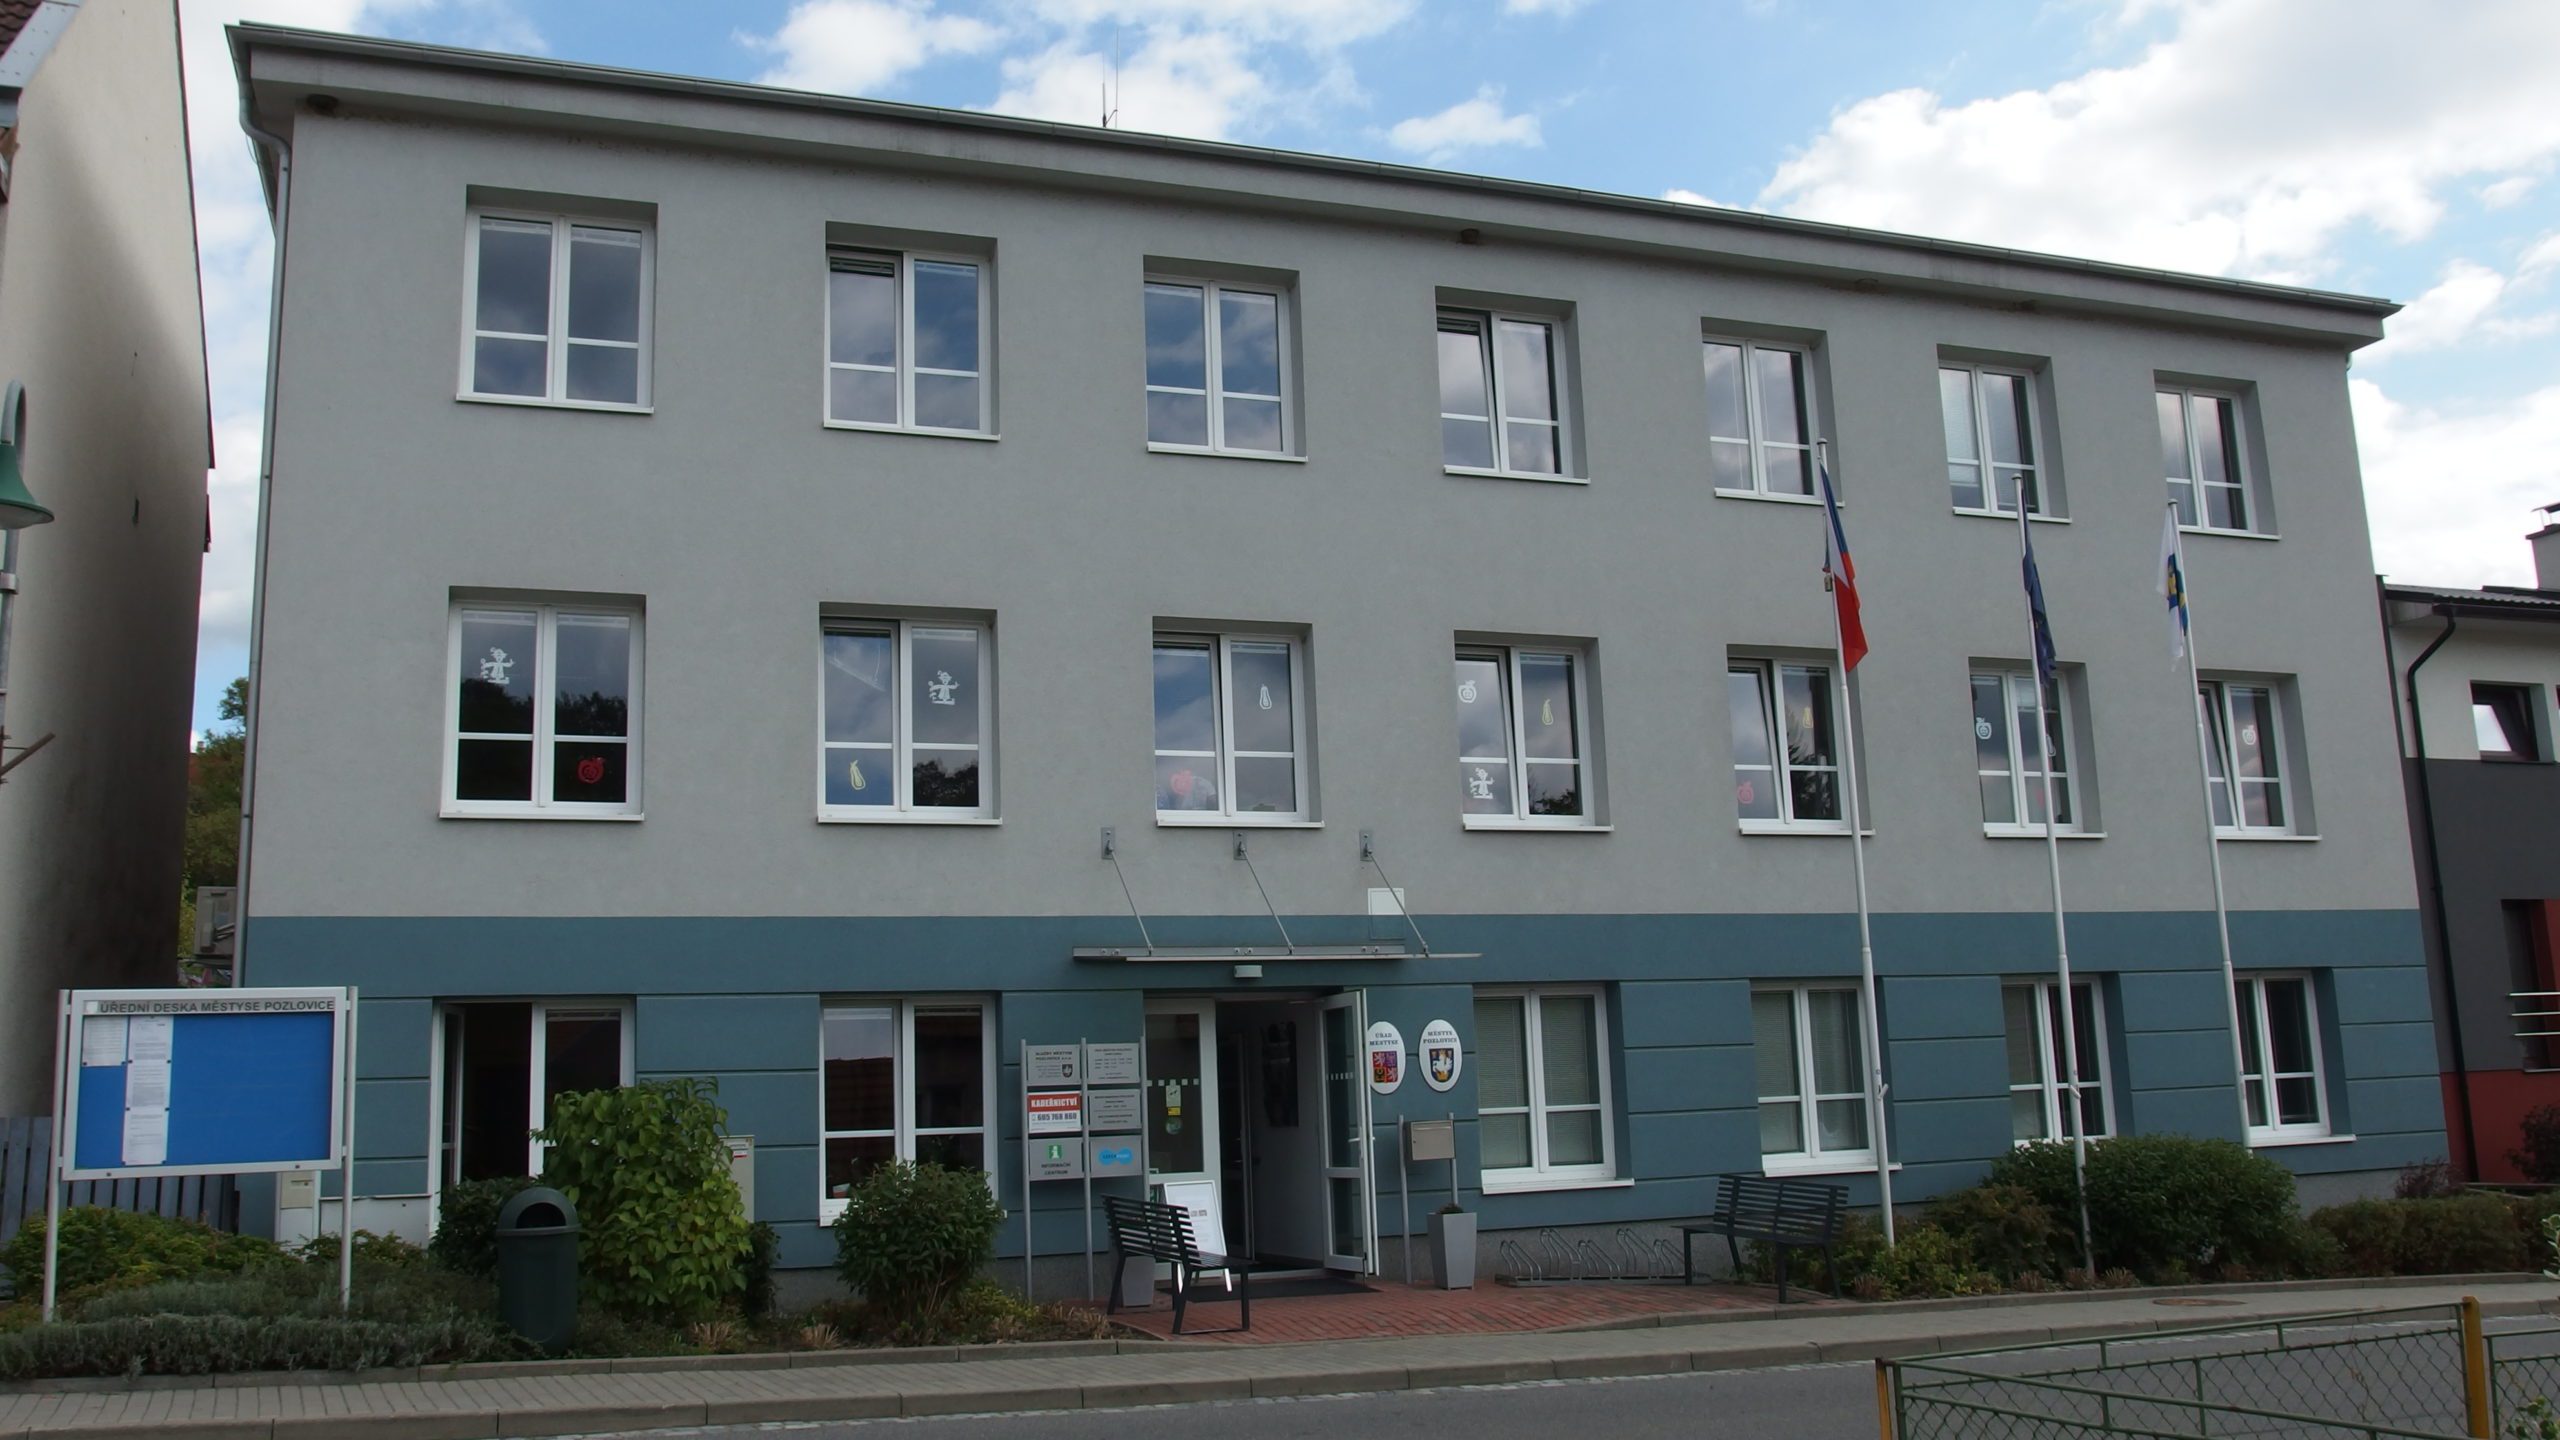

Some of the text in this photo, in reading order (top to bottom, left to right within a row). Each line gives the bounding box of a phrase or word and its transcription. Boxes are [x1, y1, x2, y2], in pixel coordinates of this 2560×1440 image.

[100, 1000, 334, 1013] ÚŘEDNÍ DESKA MĚSTYSE POZLOVICE
[1031, 1097, 1077, 1108] KADEŘNICTVÍ
